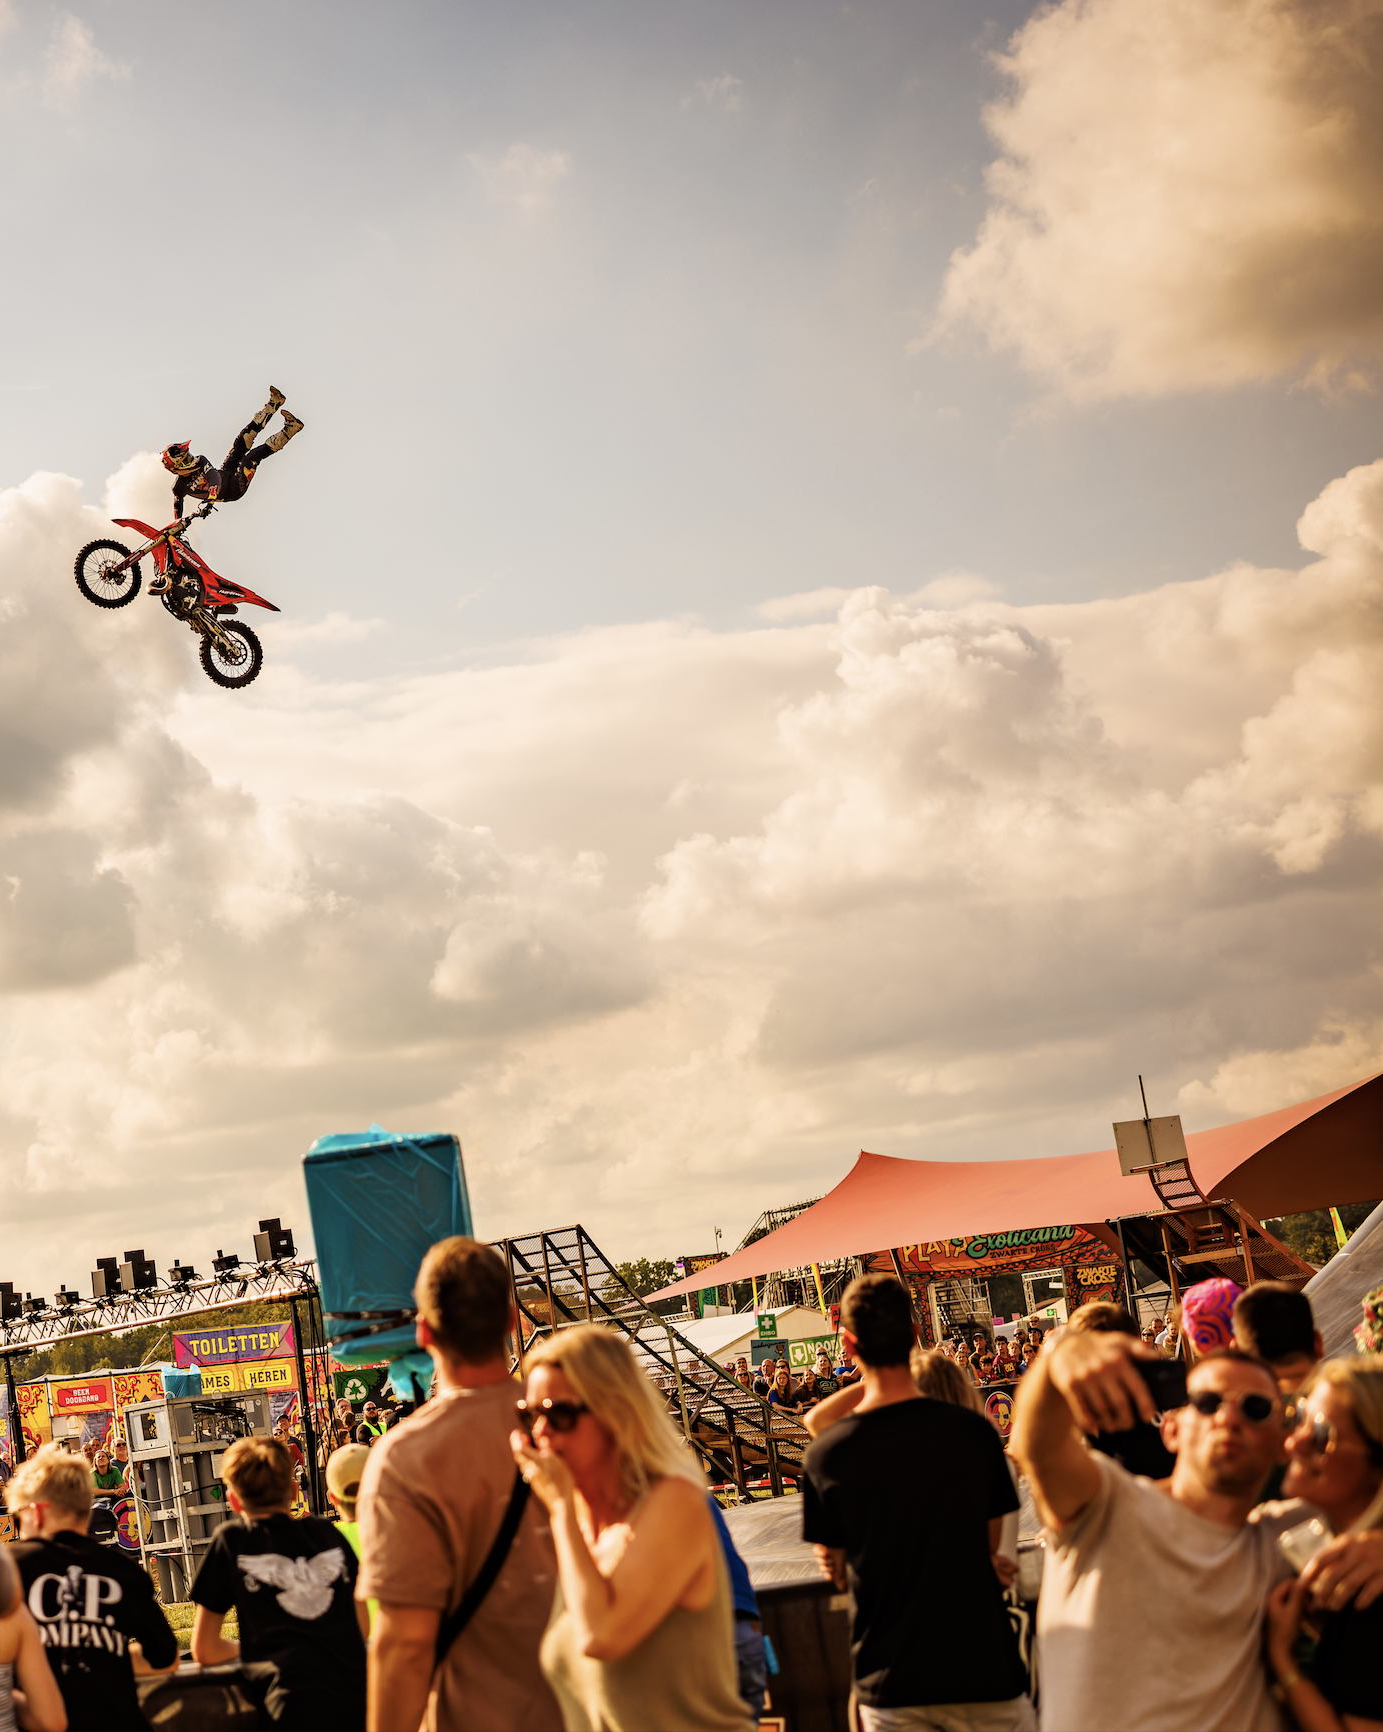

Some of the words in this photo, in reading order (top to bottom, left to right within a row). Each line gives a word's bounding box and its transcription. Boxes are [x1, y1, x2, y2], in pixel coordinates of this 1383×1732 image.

[990, 1247, 1028, 1259] ZWARTE
[1076, 1265, 1117, 1279] ZWARTE
[1080, 1274, 1116, 1285] CROSS
[189, 1331, 281, 1357] TOILETTEN
[201, 1375, 230, 1389] AMES
[249, 1369, 287, 1384] HEREN
[65, 1394, 99, 1405] DOORGANG
